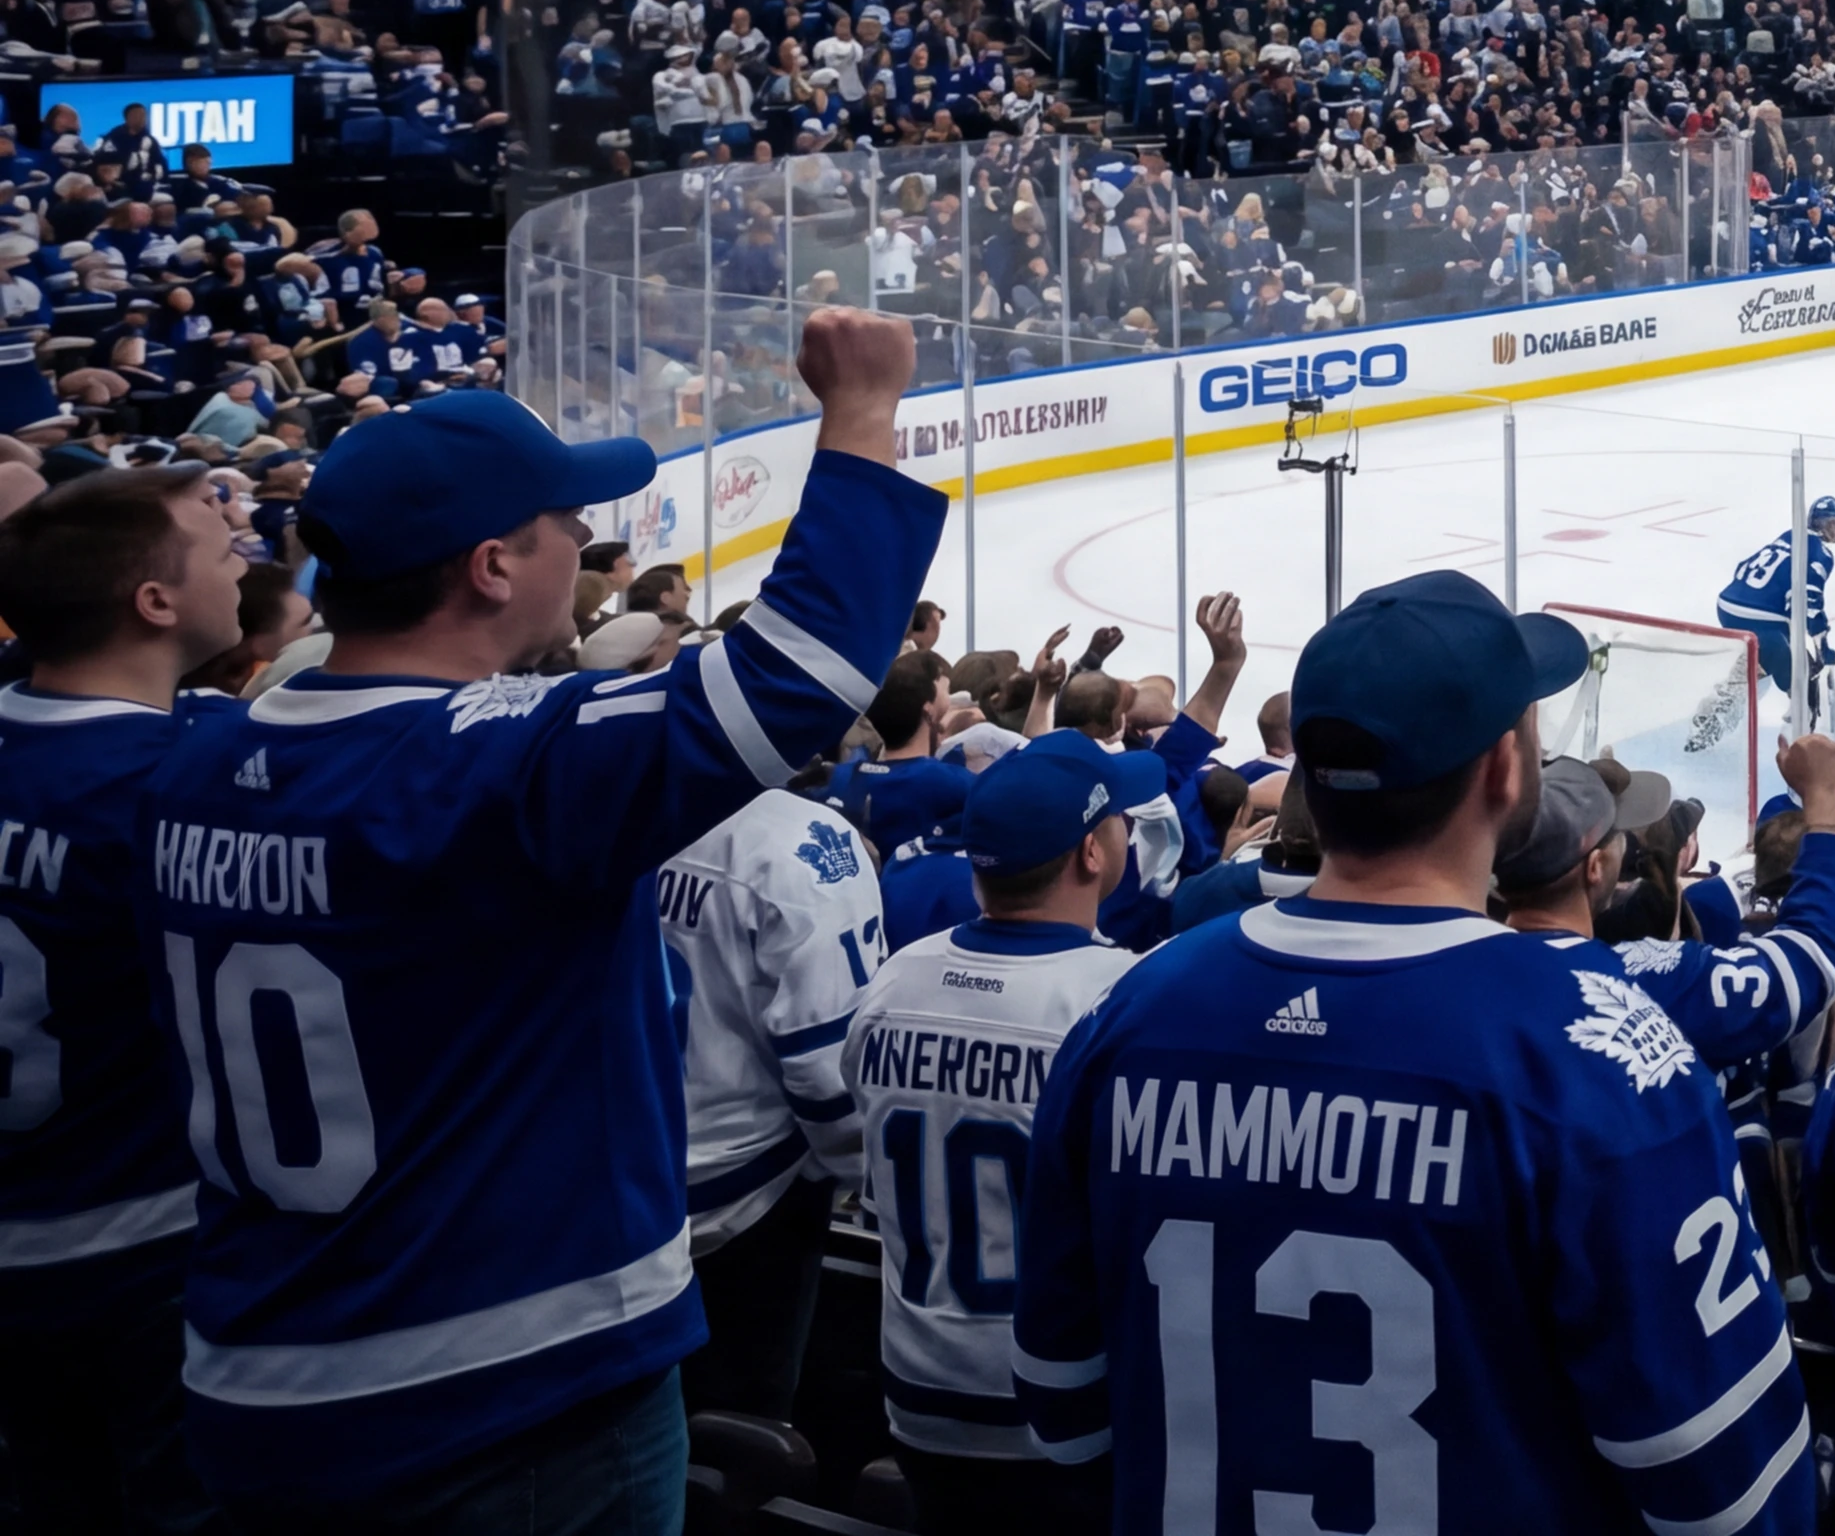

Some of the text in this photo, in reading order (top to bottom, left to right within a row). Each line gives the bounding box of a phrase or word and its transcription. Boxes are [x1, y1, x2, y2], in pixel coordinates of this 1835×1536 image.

[151, 99, 256, 148] UTAH
[1200, 342, 1408, 414] GEICO
[164, 930, 378, 1214] 10
[1109, 1075, 1469, 1207] MAMMOTH
[1143, 1218, 1439, 1536] 13
